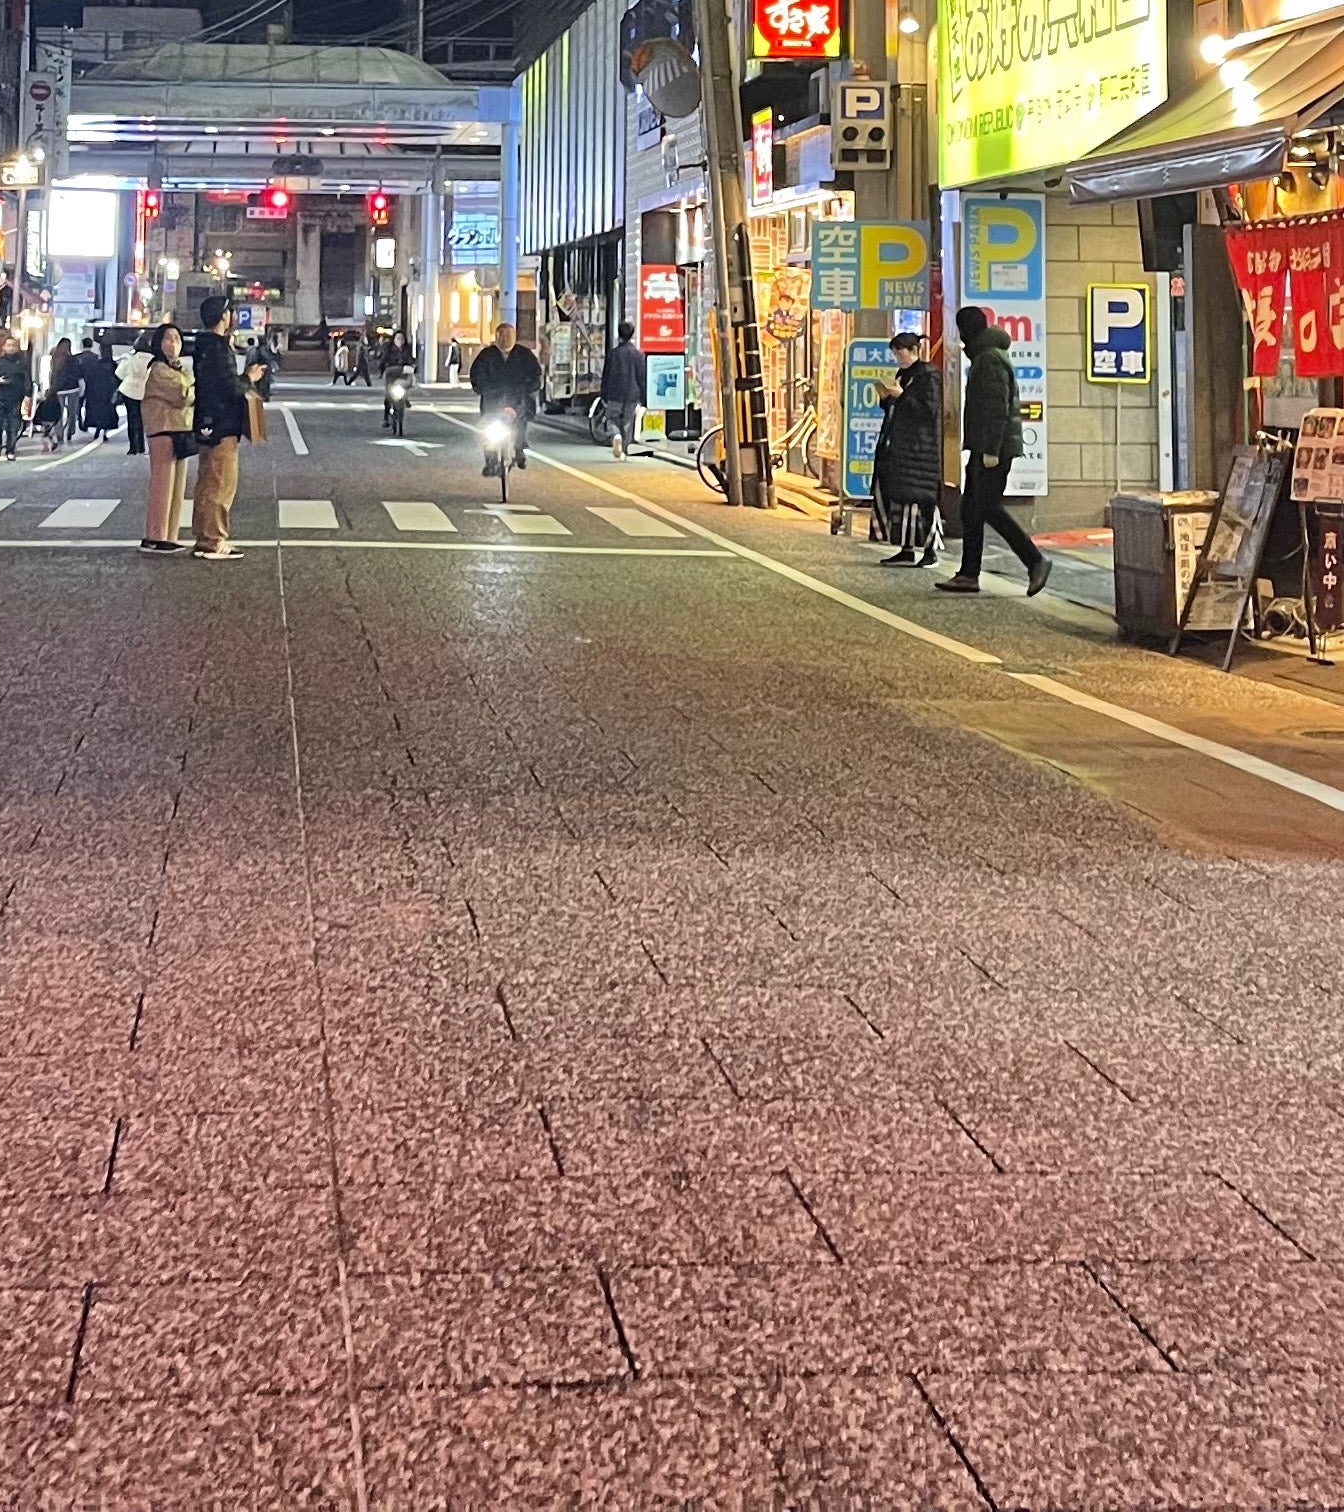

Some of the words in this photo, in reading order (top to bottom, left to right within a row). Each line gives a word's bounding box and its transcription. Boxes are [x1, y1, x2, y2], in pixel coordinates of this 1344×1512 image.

[845, 88, 881, 118] P
[980, 206, 1037, 292] P
[817, 225, 857, 307] 空車
[860, 225, 928, 309] P
[884, 280, 925, 294] NEWS
[884, 293, 922, 307] PARK
[238, 310, 250, 323] P
[1093, 288, 1144, 343] P
[1093, 349, 1144, 375] 空車
